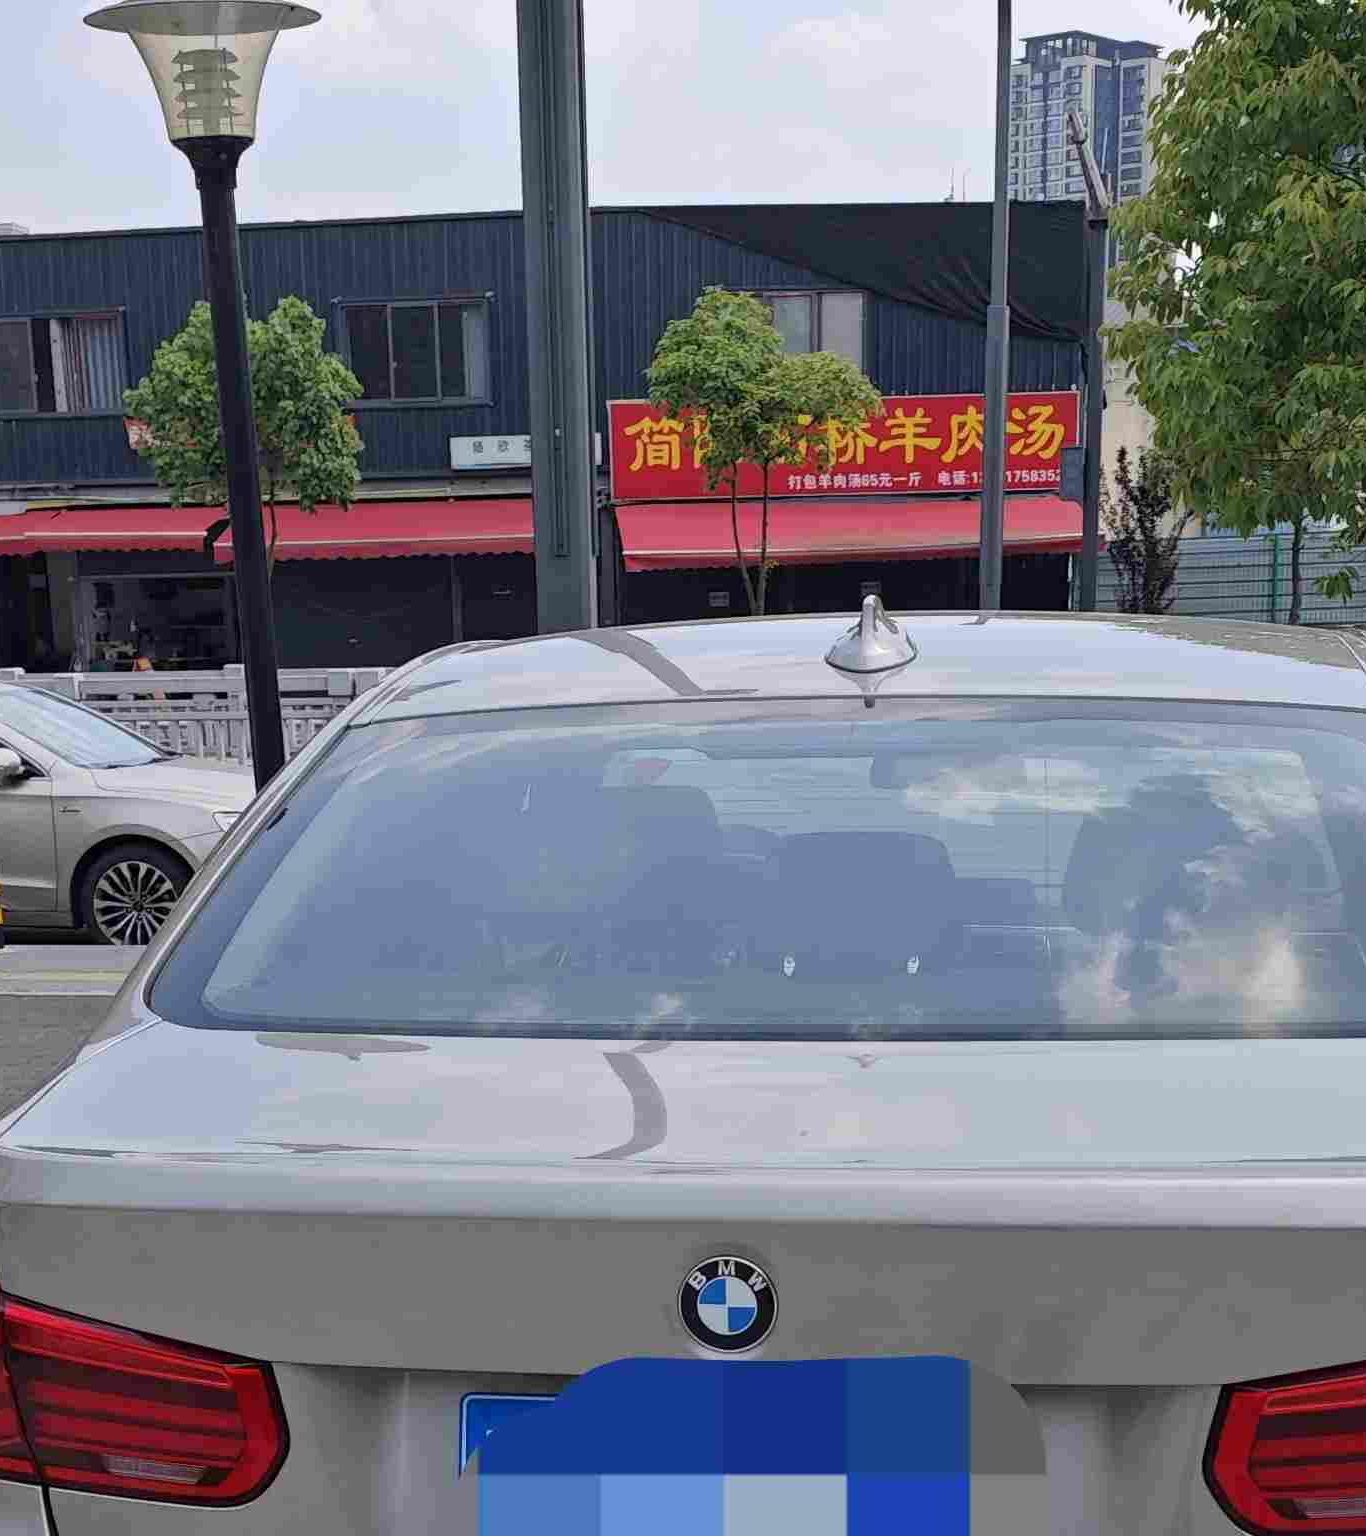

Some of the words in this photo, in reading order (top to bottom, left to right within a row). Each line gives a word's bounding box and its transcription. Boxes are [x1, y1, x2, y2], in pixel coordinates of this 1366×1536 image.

[624, 405, 1065, 471] 简桥羊肉汤
[688, 1260, 767, 1291] BMW
